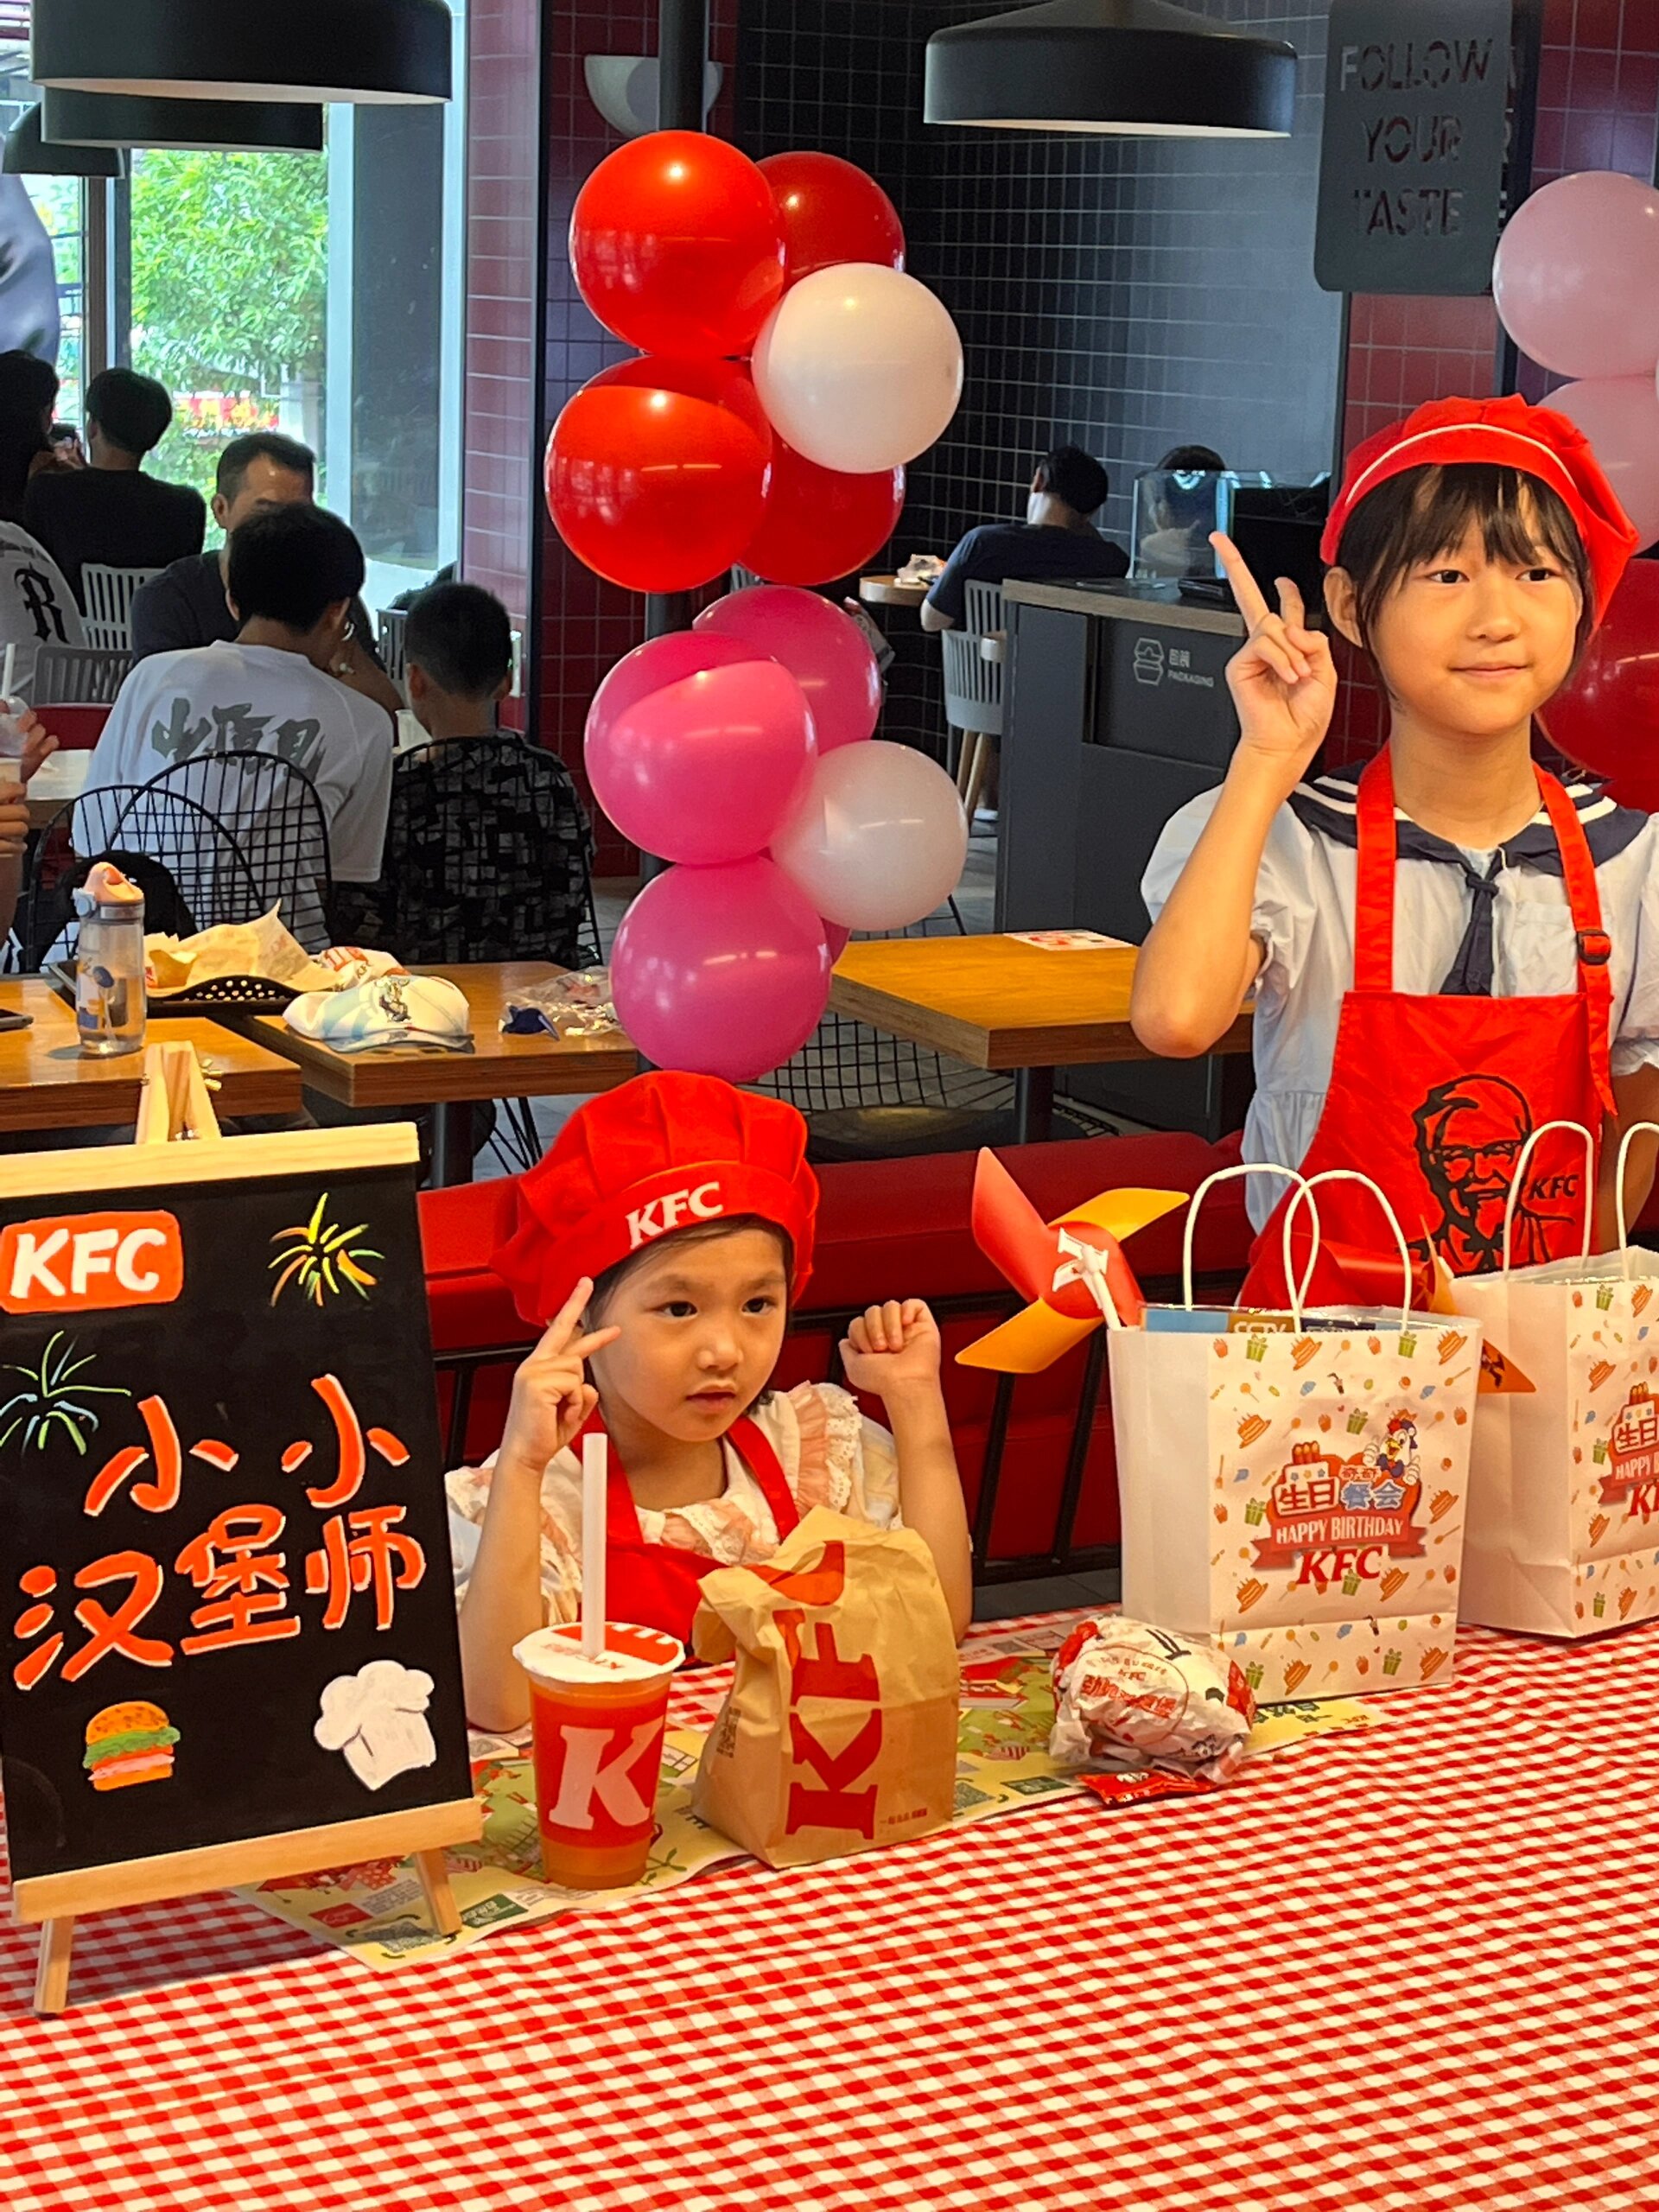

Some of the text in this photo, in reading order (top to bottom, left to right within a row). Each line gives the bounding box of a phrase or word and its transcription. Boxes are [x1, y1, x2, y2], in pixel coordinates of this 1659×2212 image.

[1340, 39, 1493, 91] FOLLOW
[1362, 116, 1461, 162] YOUR
[1354, 188, 1463, 236] TASTE
[14, 562, 71, 645] R
[1527, 1173, 1580, 1200] KFC
[624, 1181, 724, 1250] KFC
[10, 1228, 168, 1300] KFC
[1617, 1417, 1658, 1451] 生日
[1615, 1454, 1651, 1480] HAPPY
[1276, 1515, 1404, 1545] HAPPY BIRTHDAY
[1297, 1545, 1383, 1585] KFC
[12, 1503, 428, 1691] 汉堡师
[549, 1714, 664, 1831] K
